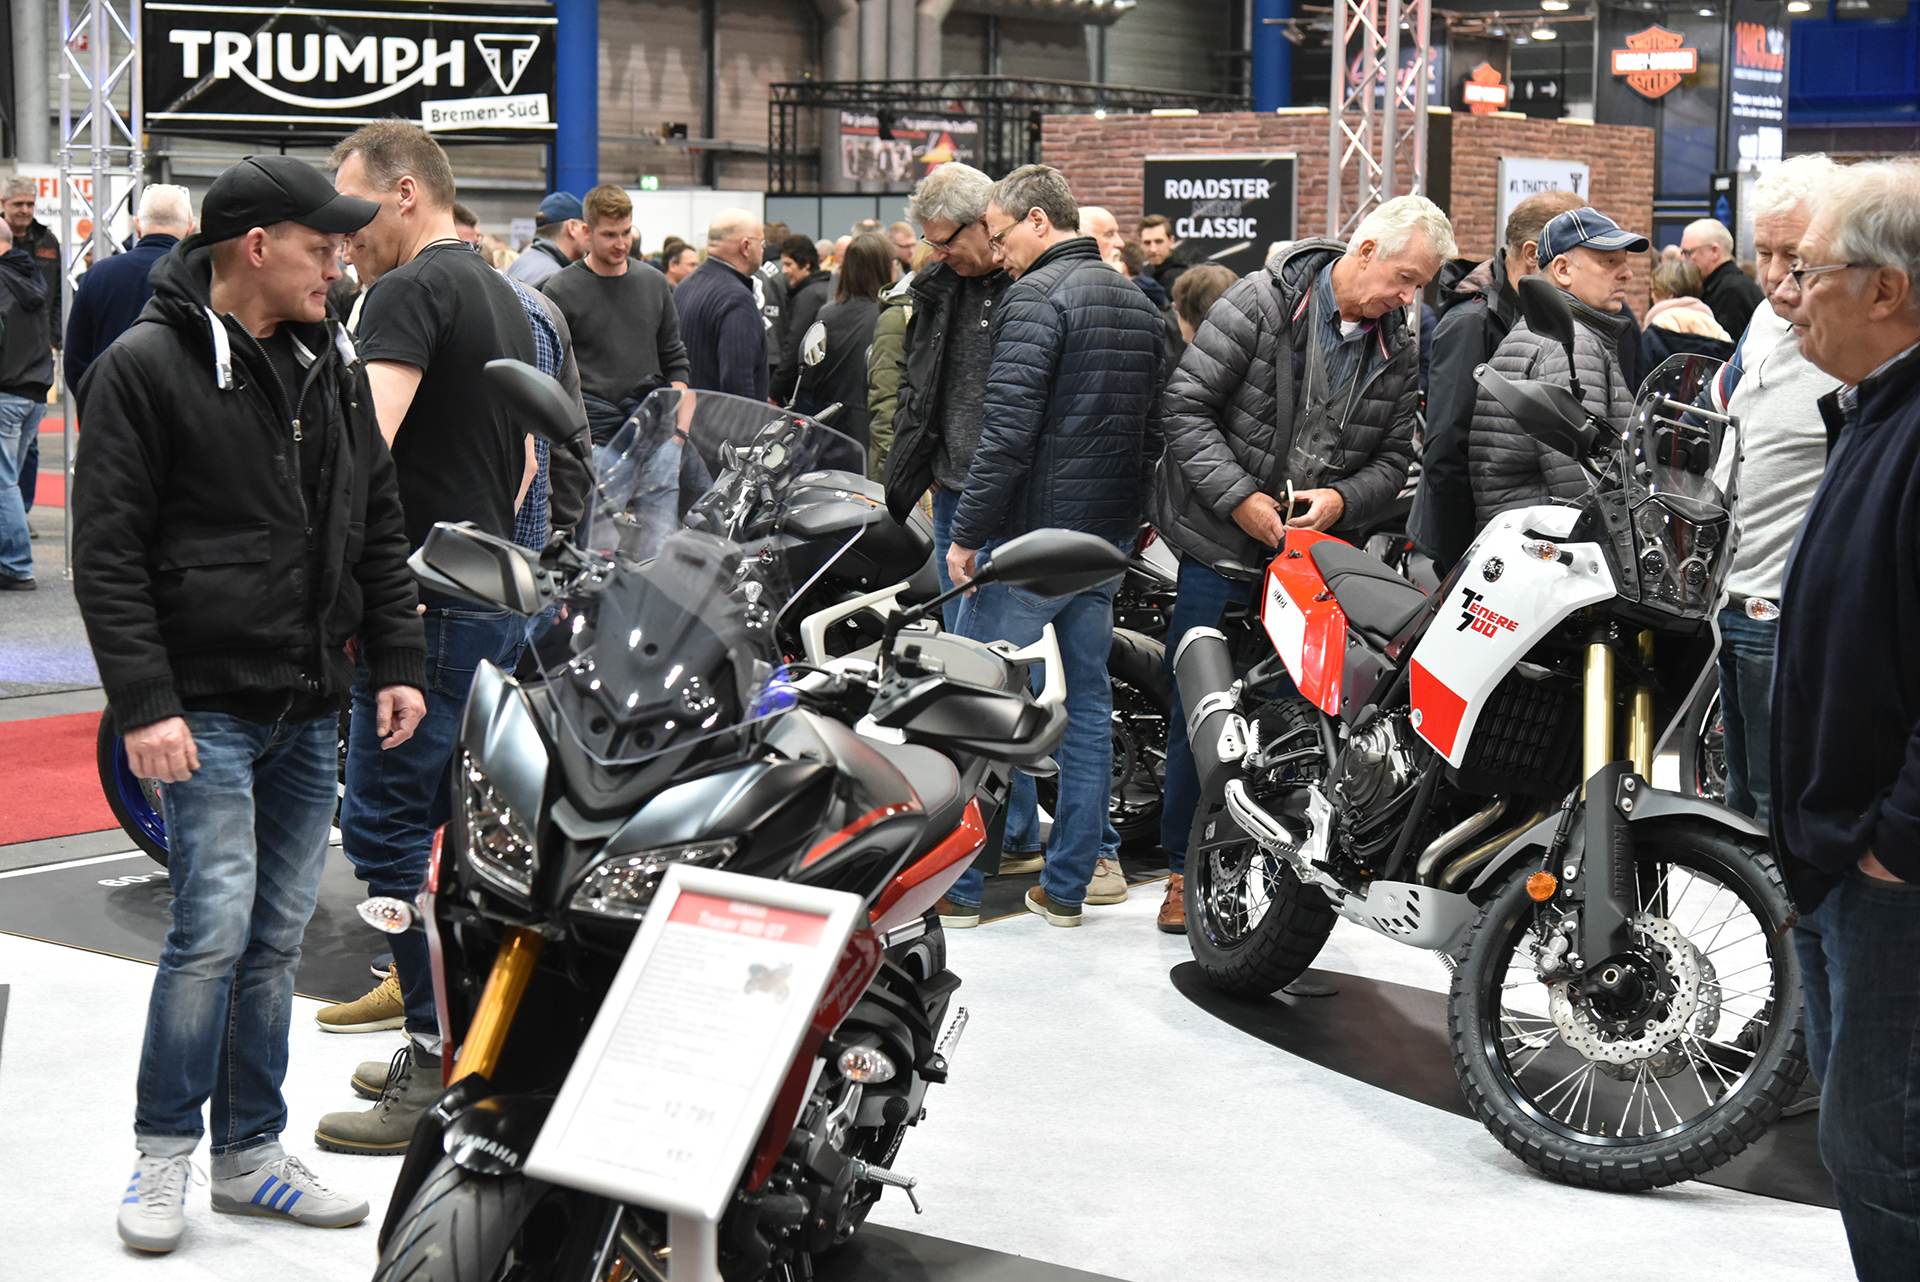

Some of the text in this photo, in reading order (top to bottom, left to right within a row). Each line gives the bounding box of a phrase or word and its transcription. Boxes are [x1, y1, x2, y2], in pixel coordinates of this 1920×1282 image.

[168, 29, 466, 108] TRIUMPH
[431, 101, 541, 123] Bremen-Süd
[1164, 178, 1271, 199] ROADSTER
[1175, 217, 1258, 238] CLASSIC
[453, 1133, 519, 1168] YAMAHA
